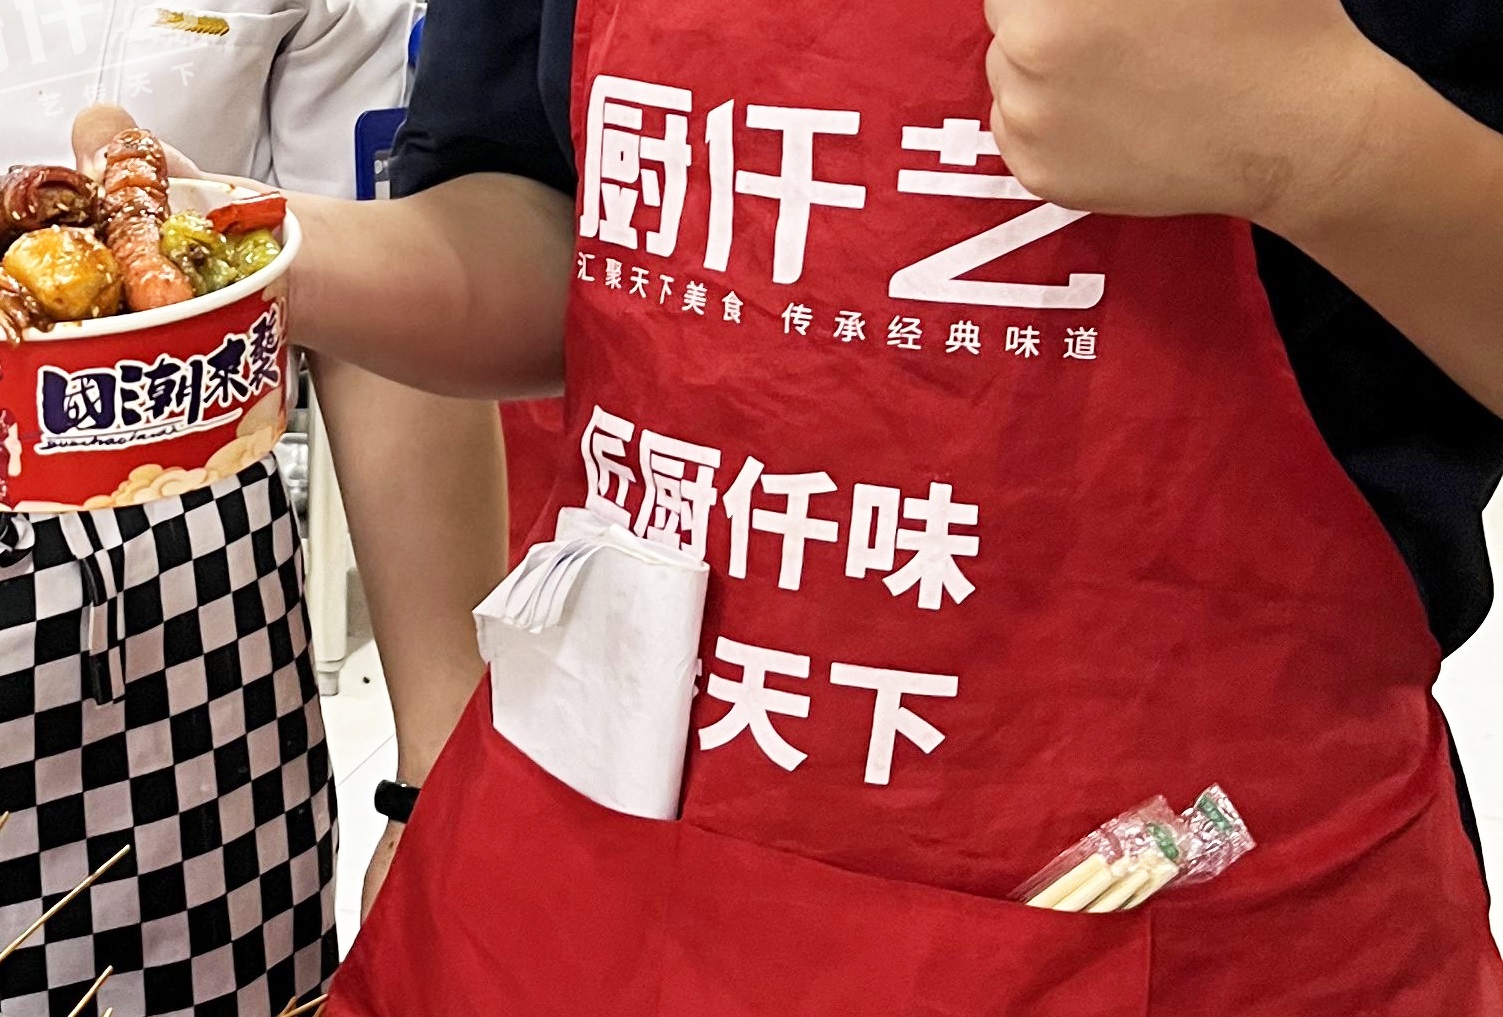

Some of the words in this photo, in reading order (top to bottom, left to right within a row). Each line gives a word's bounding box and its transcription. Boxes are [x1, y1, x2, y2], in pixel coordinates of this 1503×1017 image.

[579, 74, 1107, 310] 厨仟艺
[577, 251, 745, 325] 汇聚天下美食
[781, 302, 1099, 361] 传承经典味道
[580, 404, 981, 611] 匠厨仟味
[693, 635, 959, 786] 天下
